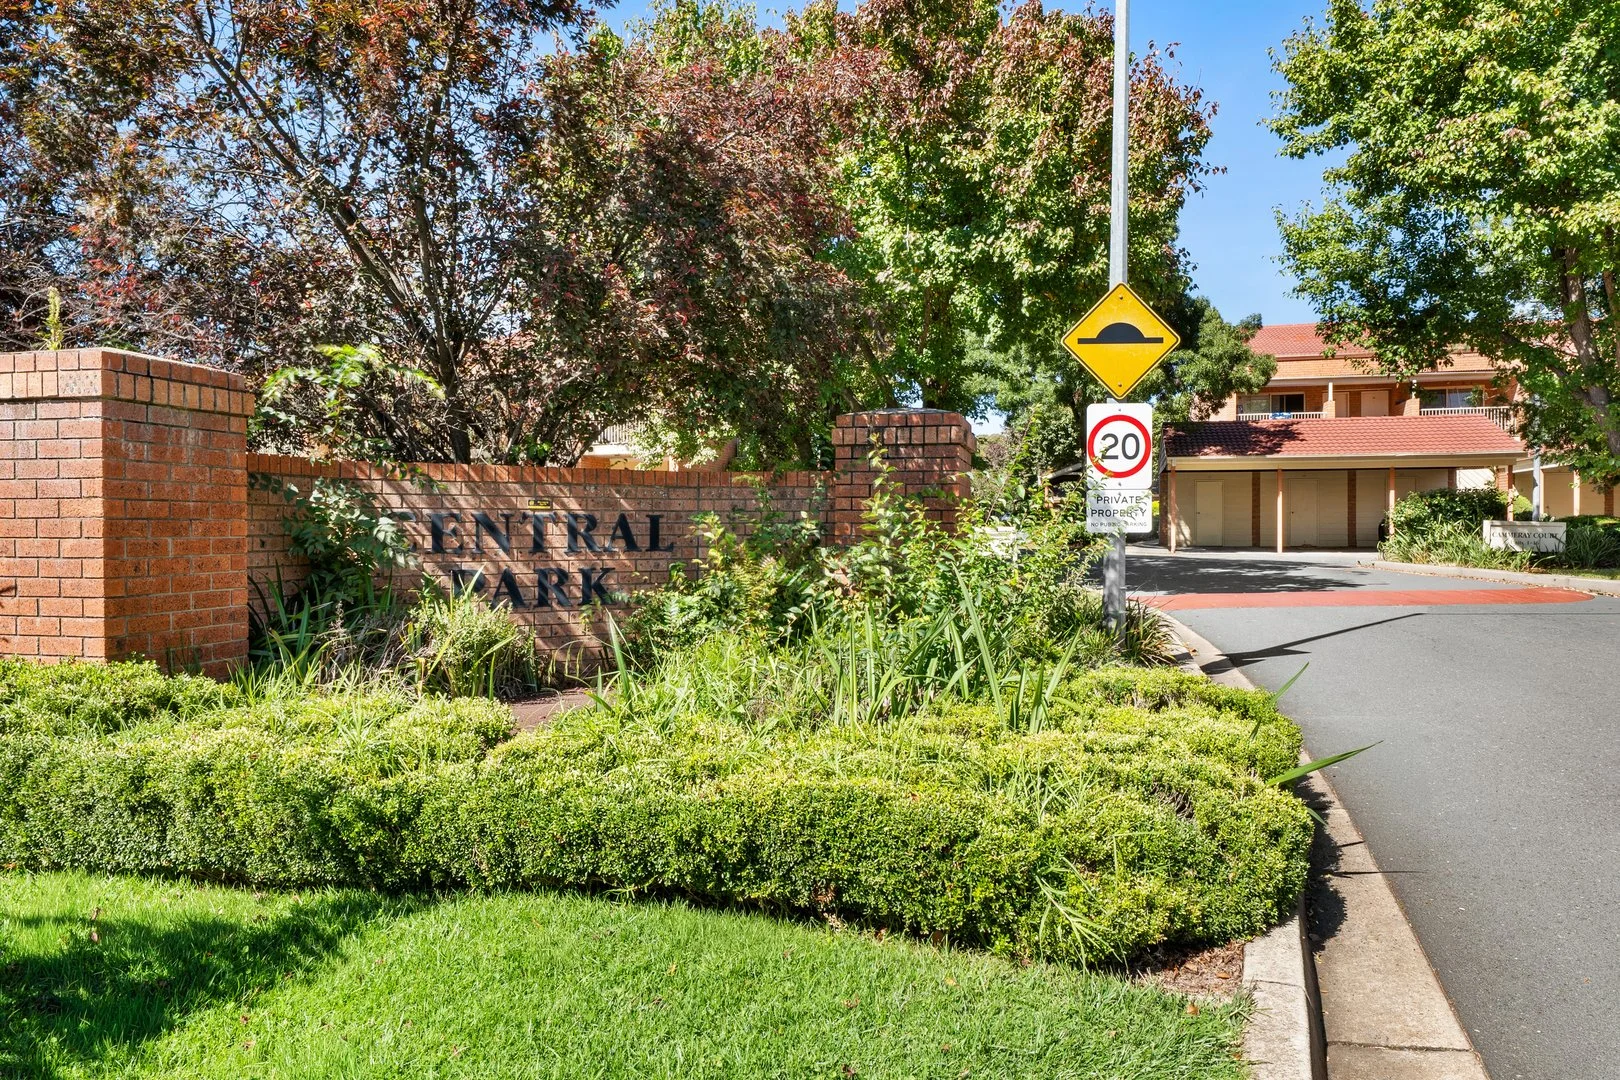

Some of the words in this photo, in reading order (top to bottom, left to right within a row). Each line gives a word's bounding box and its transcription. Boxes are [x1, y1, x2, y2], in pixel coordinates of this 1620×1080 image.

[1101, 433, 1140, 460] 20
[1096, 496, 1142, 504] PRIVATE
[450, 567, 615, 609] PARK
